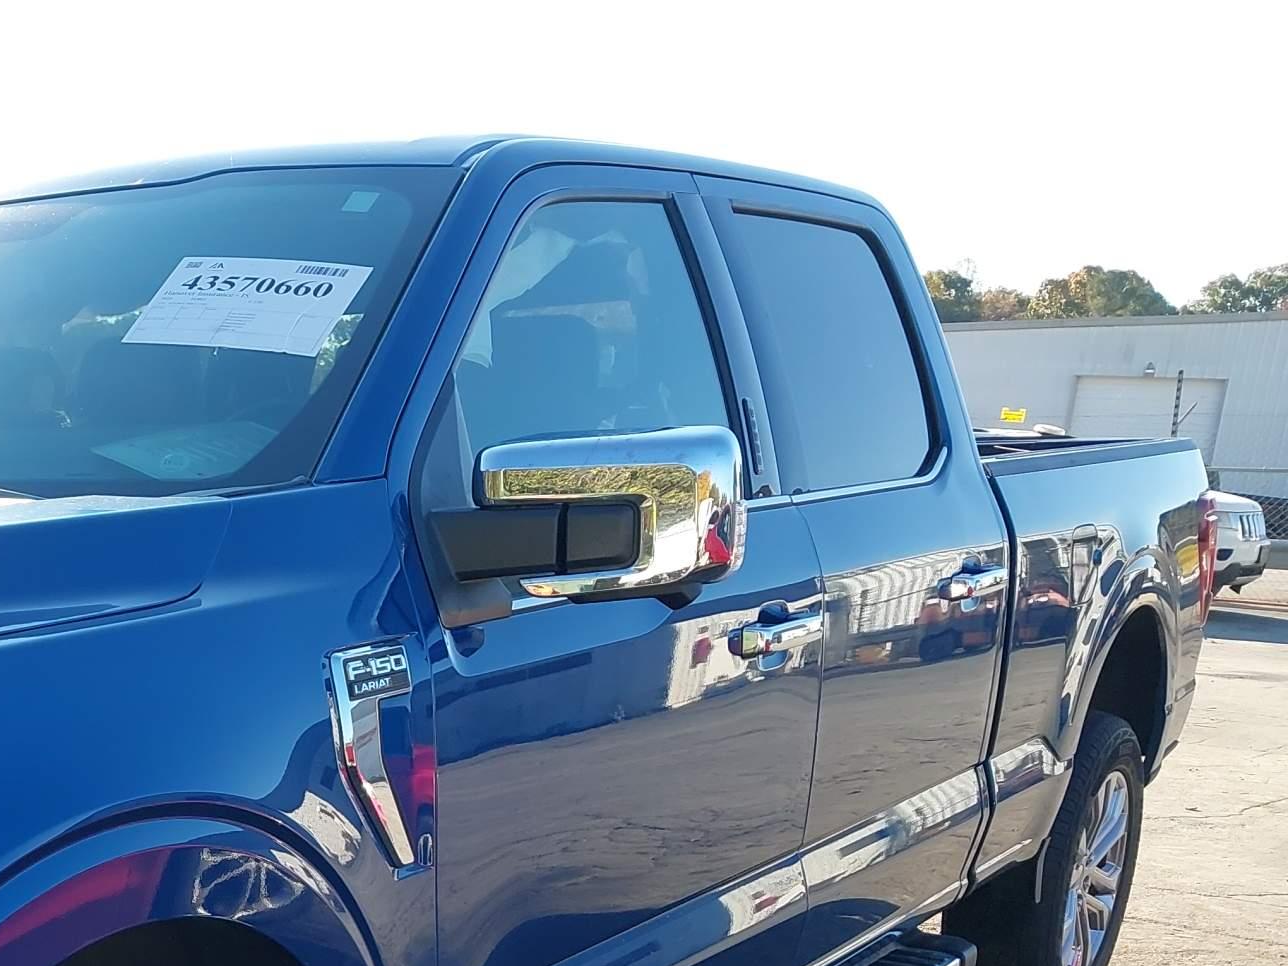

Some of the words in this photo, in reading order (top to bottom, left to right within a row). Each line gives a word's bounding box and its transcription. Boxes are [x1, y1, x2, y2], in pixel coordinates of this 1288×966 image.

[181, 274, 334, 298] 43570660
[347, 654, 407, 680] F-150
[354, 678, 391, 694] LARIAT
